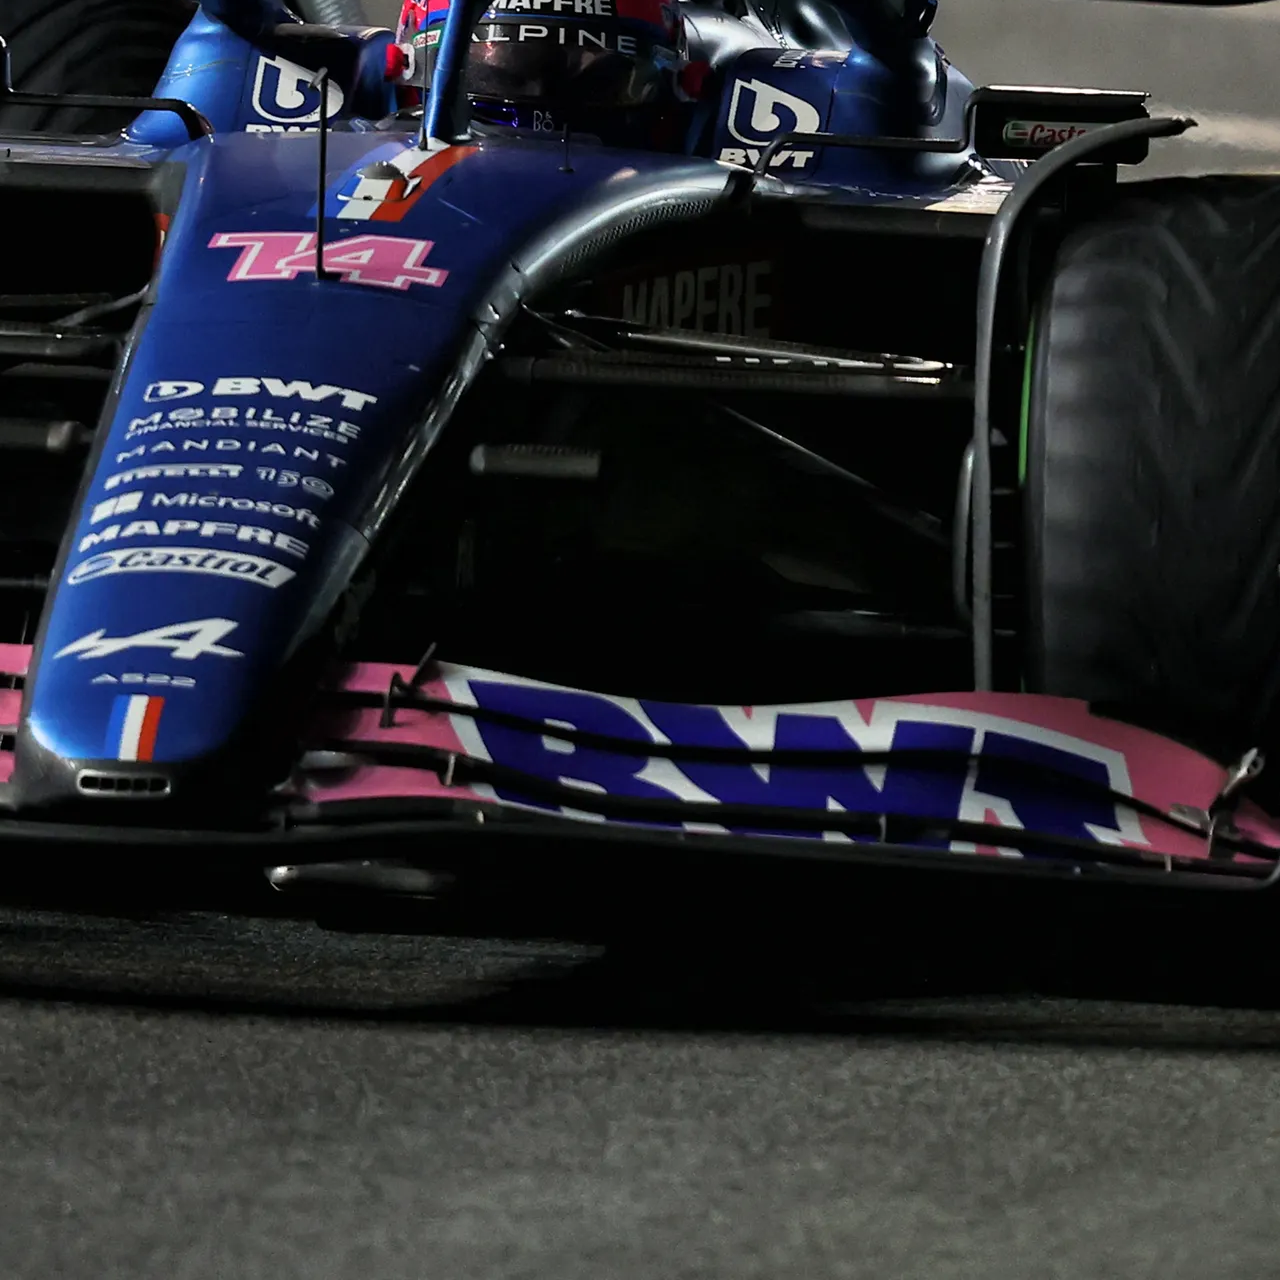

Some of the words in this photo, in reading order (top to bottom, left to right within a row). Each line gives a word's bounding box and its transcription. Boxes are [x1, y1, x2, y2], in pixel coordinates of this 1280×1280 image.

[207, 231, 450, 291] 14
[622, 260, 773, 339] MAPFRE
[212, 376, 379, 412] BWT
[124, 419, 241, 440] FINANCIAL
[245, 419, 350, 445] SERVICES
[127, 406, 362, 440] MOBILIZE
[115, 438, 348, 469] MANDIANT
[150, 491, 322, 530] Microsoft
[78, 519, 311, 560] MAPFRE
[118, 548, 279, 582] Castrol
